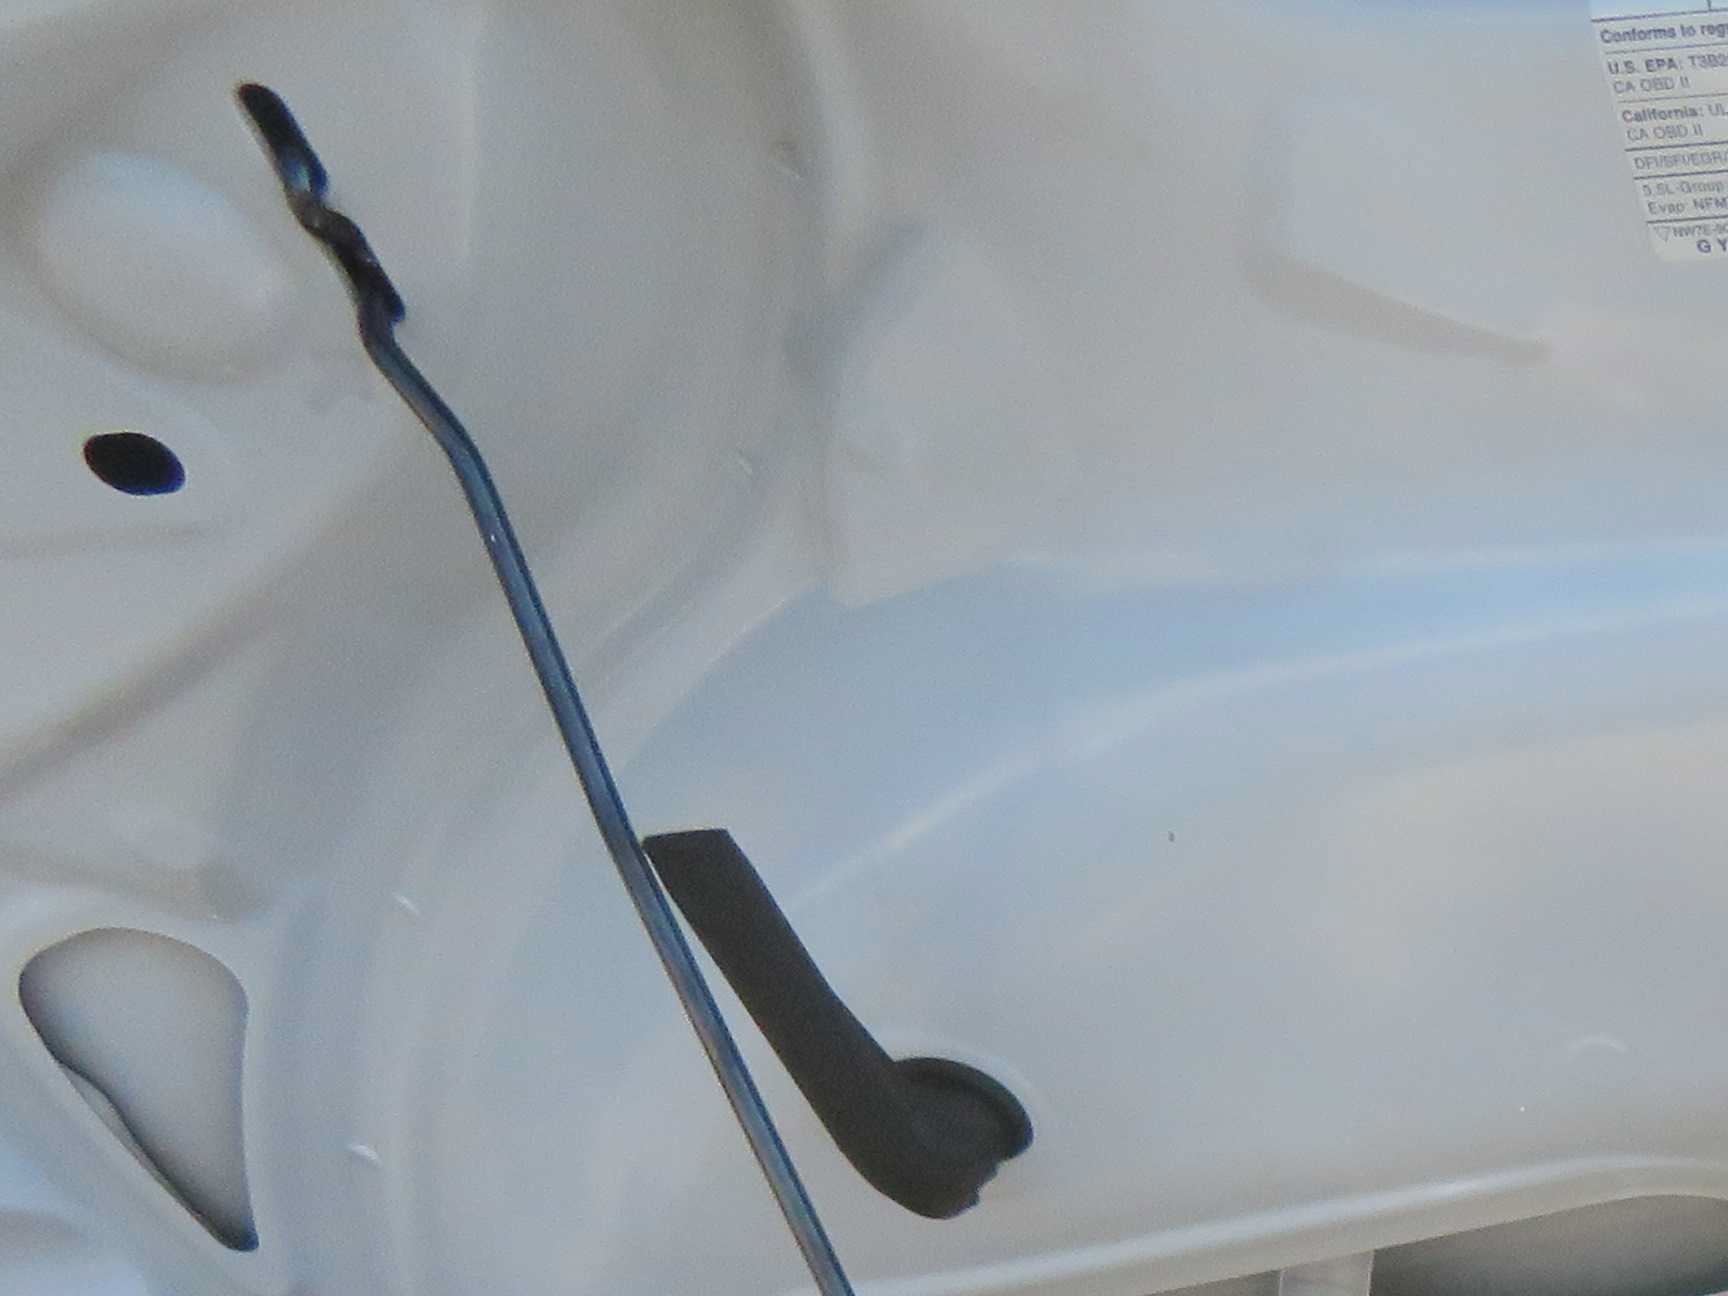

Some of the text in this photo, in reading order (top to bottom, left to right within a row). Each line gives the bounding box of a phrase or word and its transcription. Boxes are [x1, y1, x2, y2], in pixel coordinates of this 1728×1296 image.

[1600, 27, 1676, 43] Conforms
[1680, 25, 1696, 37] to
[1606, 59, 1639, 75] U.S.
[1645, 57, 1681, 72] EPA:
[1612, 79, 1635, 94] CA
[1639, 77, 1675, 92] OBD
[1622, 106, 1703, 123] California:
[1626, 126, 1650, 142] CA
[1653, 124, 1688, 140] OBD
